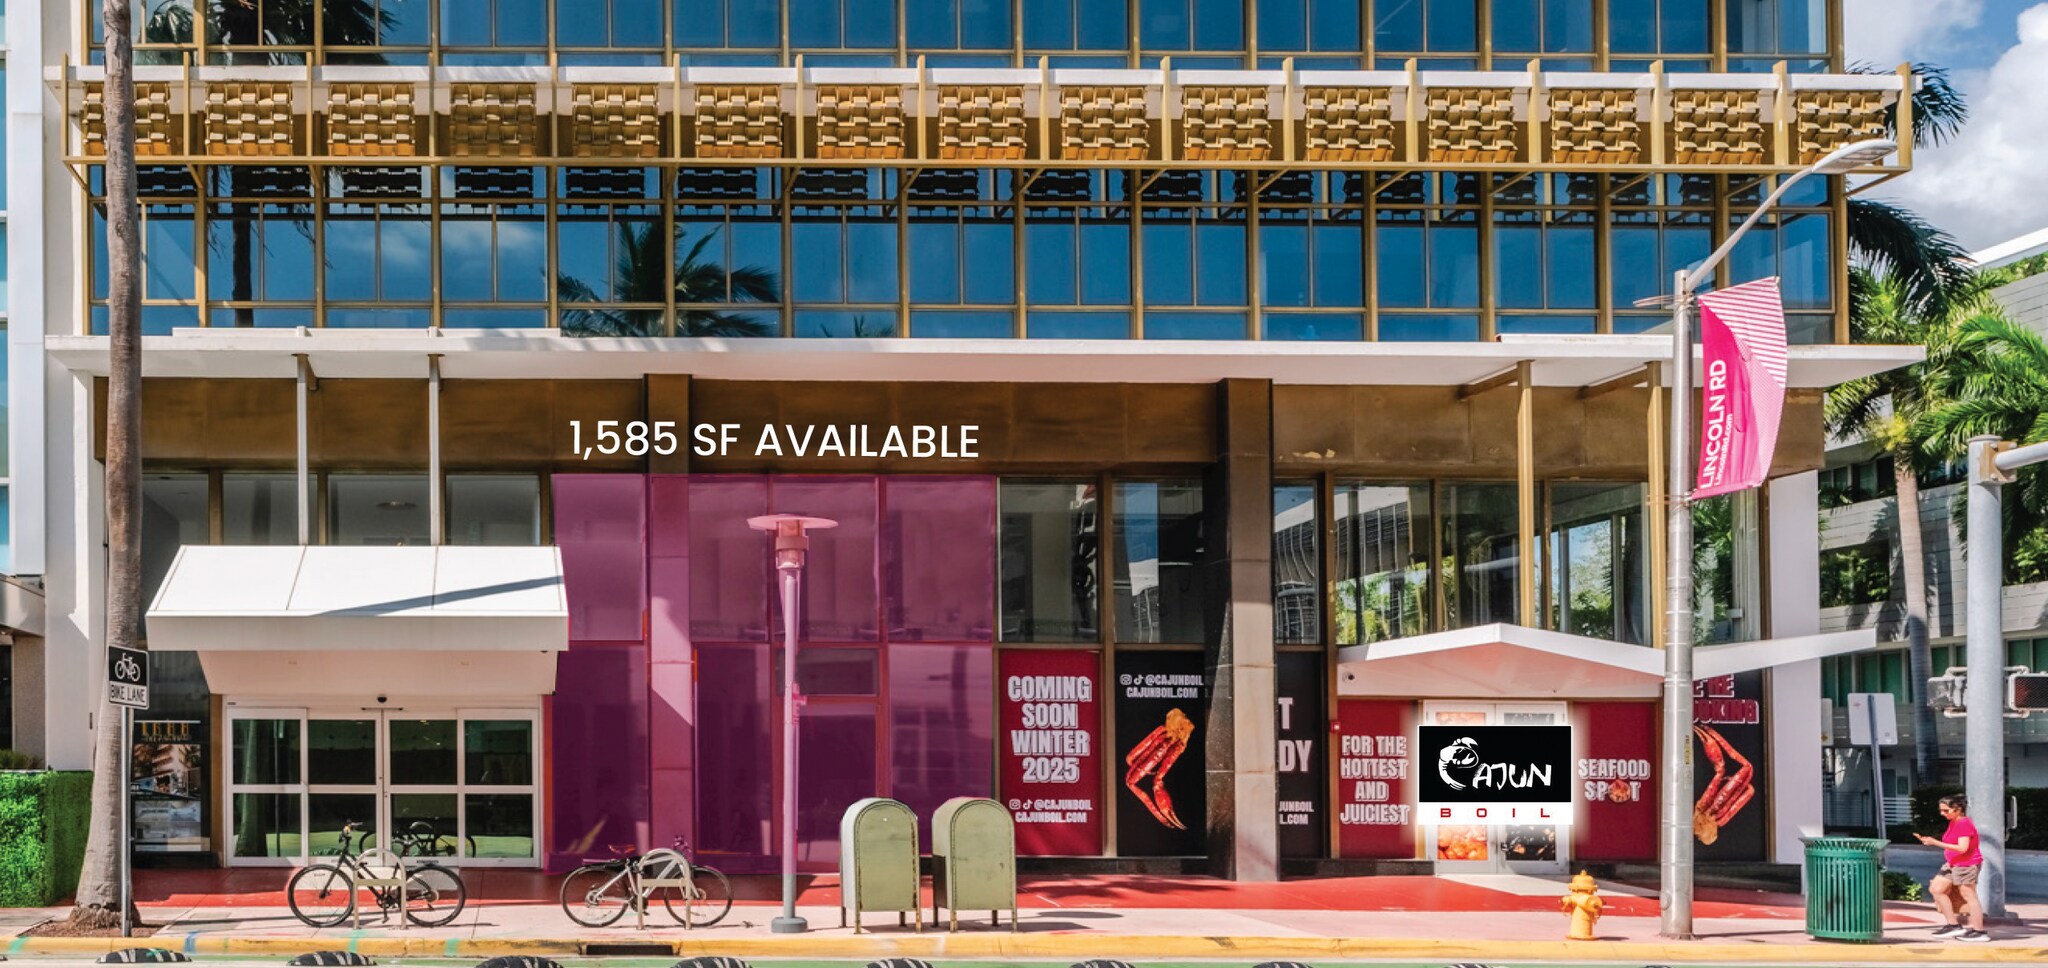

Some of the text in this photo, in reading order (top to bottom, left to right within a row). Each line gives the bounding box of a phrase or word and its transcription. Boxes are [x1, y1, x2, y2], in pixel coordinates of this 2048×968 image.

[1700, 359, 1727, 489] LINCOLN RD
[1008, 675, 1092, 702] COMING
[1145, 674, 1204, 686] @CAJUNBOIL
[111, 684, 146, 703] BIKE LANE
[1126, 687, 1198, 699] CAJUNBOIL.COM
[1022, 703, 1078, 729] SOON
[1011, 730, 1091, 756] WINTER
[1341, 735, 1407, 757] FOR THE
[1023, 757, 1080, 783] 2025
[1340, 758, 1409, 780] HOTTEST
[1578, 759, 1651, 780] SEAFOOD
[1354, 781, 1390, 802] AND
[1034, 799, 1093, 811] @CAJUNBOIL
[1340, 803, 1410, 825] JUICIEST
[1015, 811, 1087, 823] CAJUNBOIL.COM
